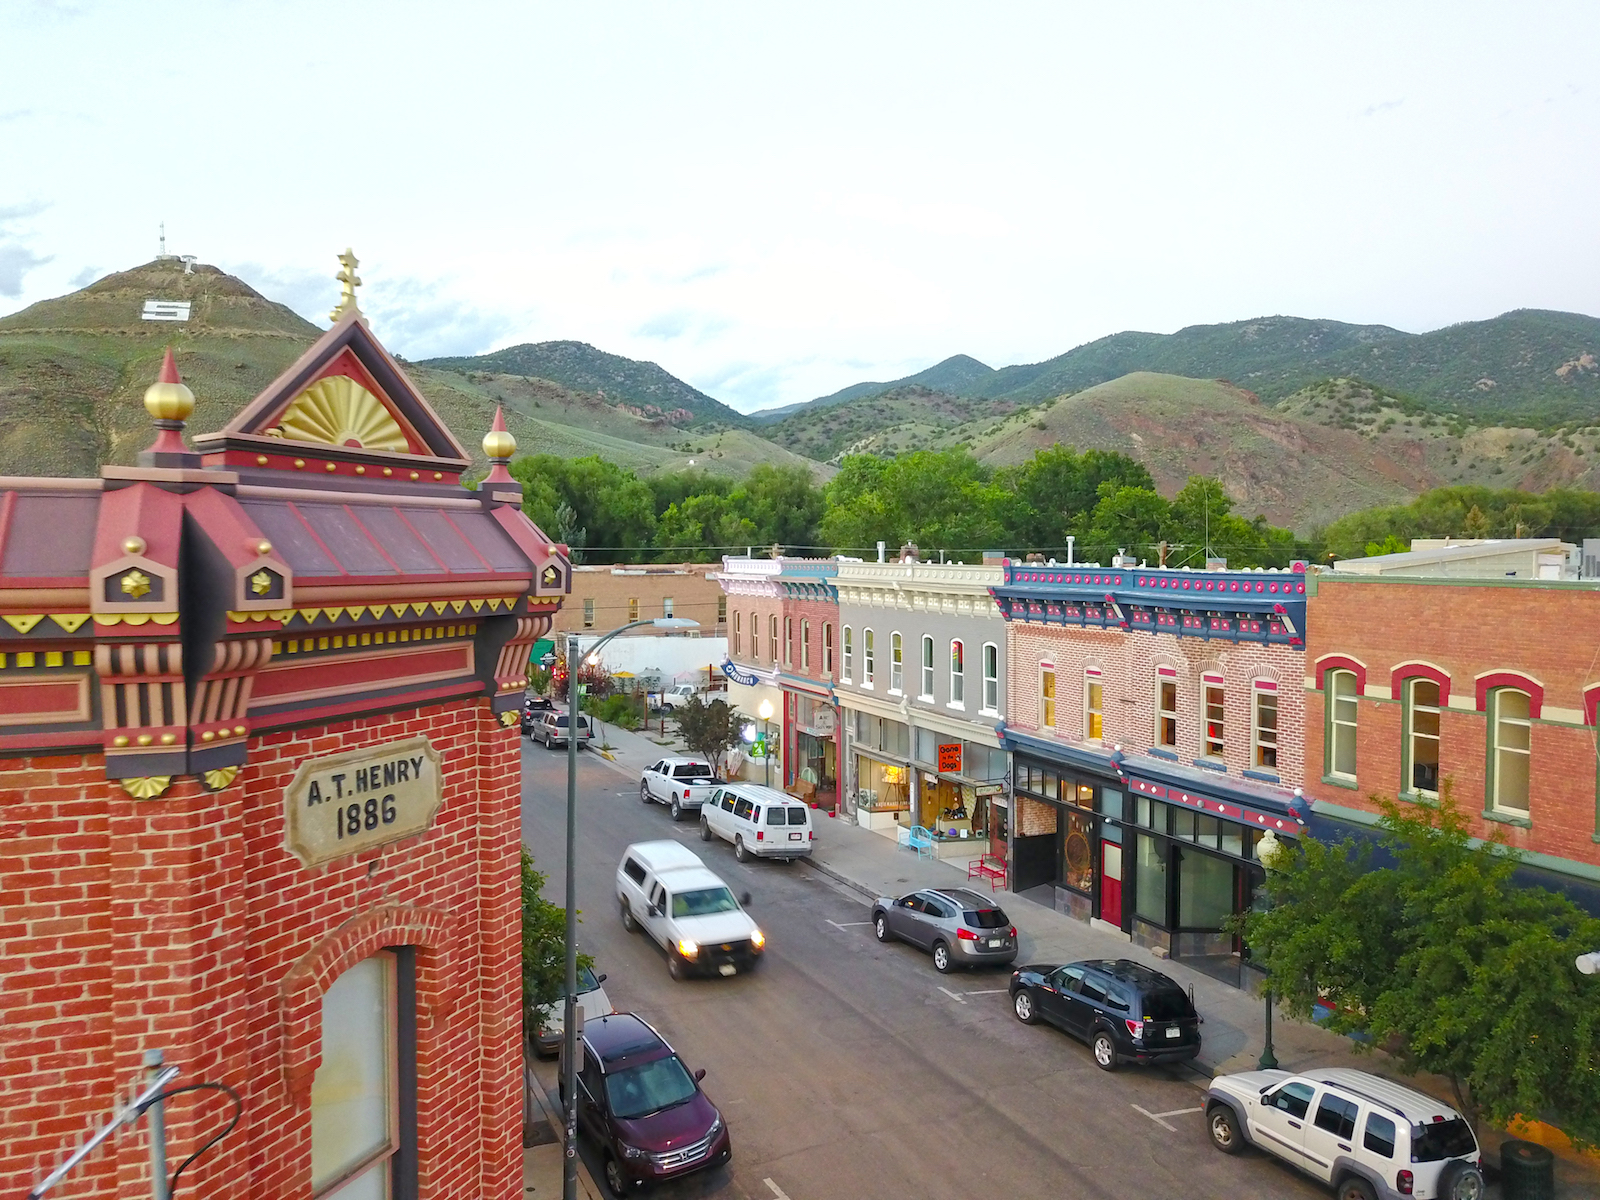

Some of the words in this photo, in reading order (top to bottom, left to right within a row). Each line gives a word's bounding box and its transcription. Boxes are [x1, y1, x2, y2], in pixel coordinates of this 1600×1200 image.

[141, 300, 192, 321] S
[942, 762, 956, 770] Dogs
[337, 793, 397, 840] 1886
